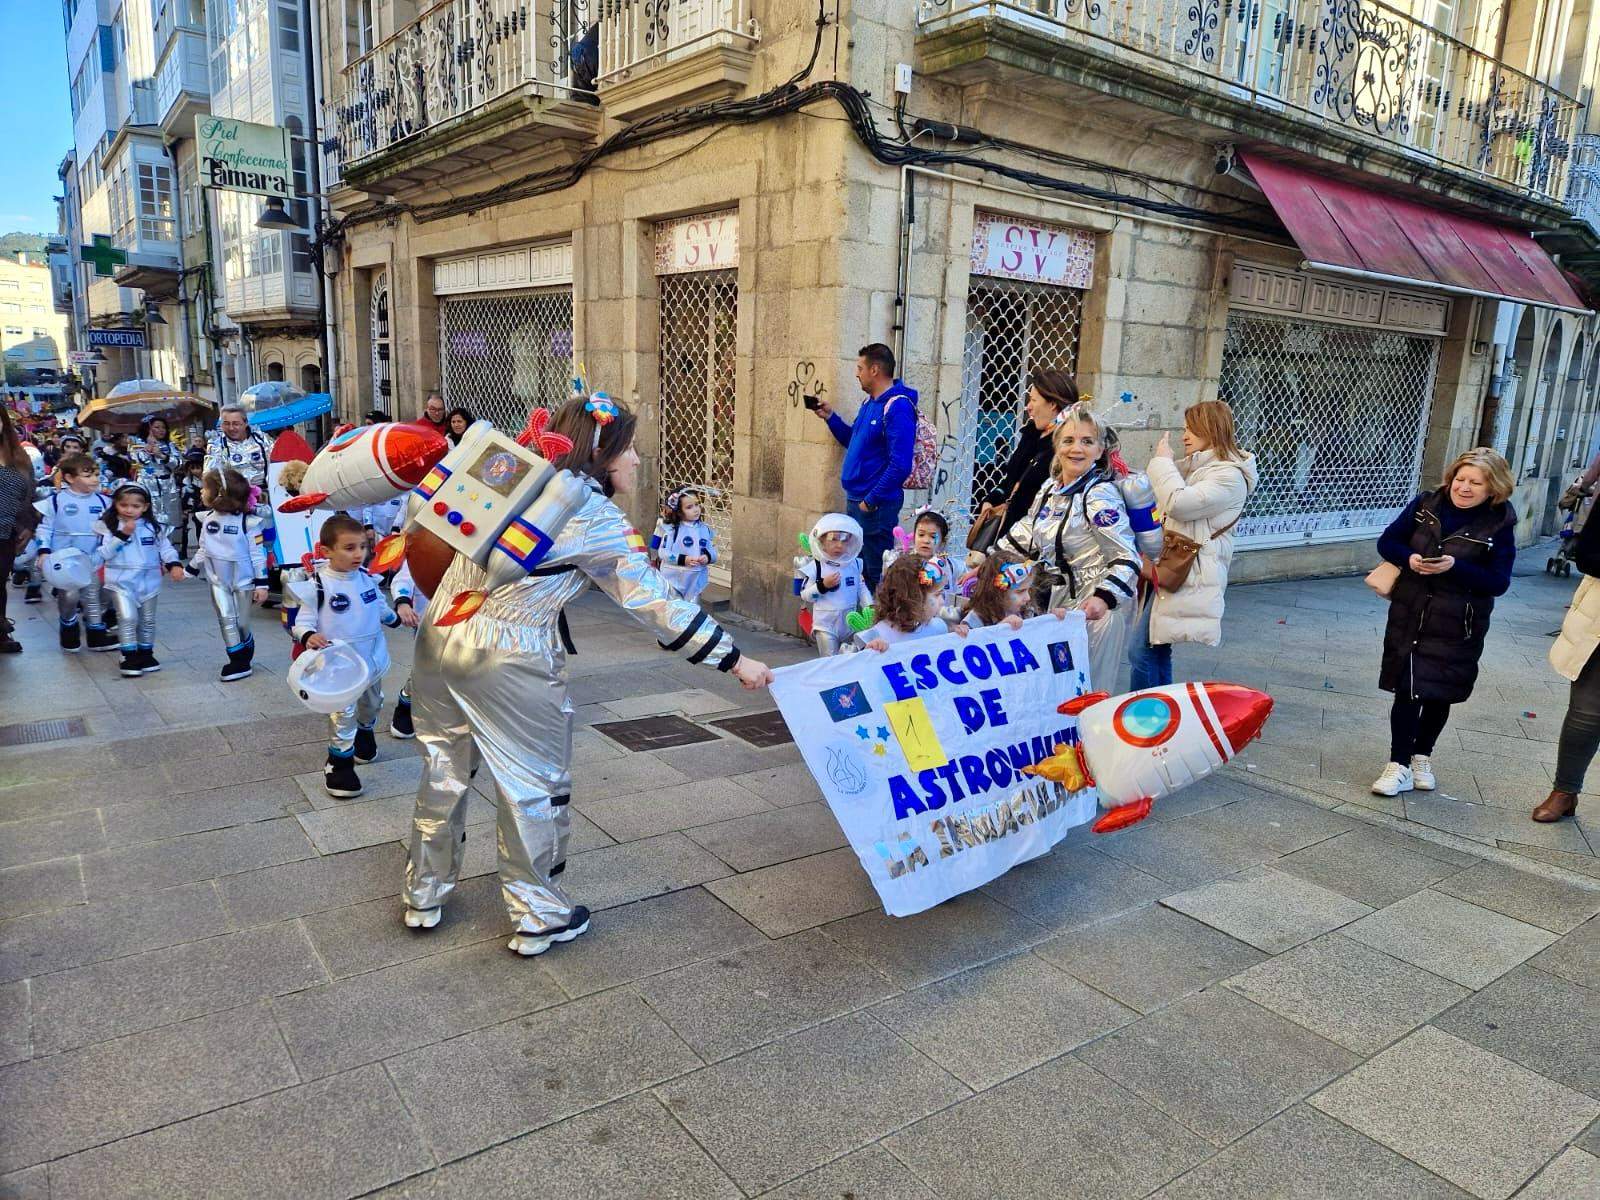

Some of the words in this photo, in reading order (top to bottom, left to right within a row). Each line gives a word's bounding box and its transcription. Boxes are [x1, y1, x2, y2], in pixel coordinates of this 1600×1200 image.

[200, 118, 238, 140] Piel
[203, 156, 286, 192] Tamara
[206, 139, 288, 169] Confecciones
[685, 218, 726, 266] SV
[1001, 226, 1058, 276] SV
[89, 332, 143, 346] ORTOPEDIA
[882, 638, 1041, 702] ESCOLA
[953, 688, 1009, 735] DE
[873, 832, 929, 880] LA
